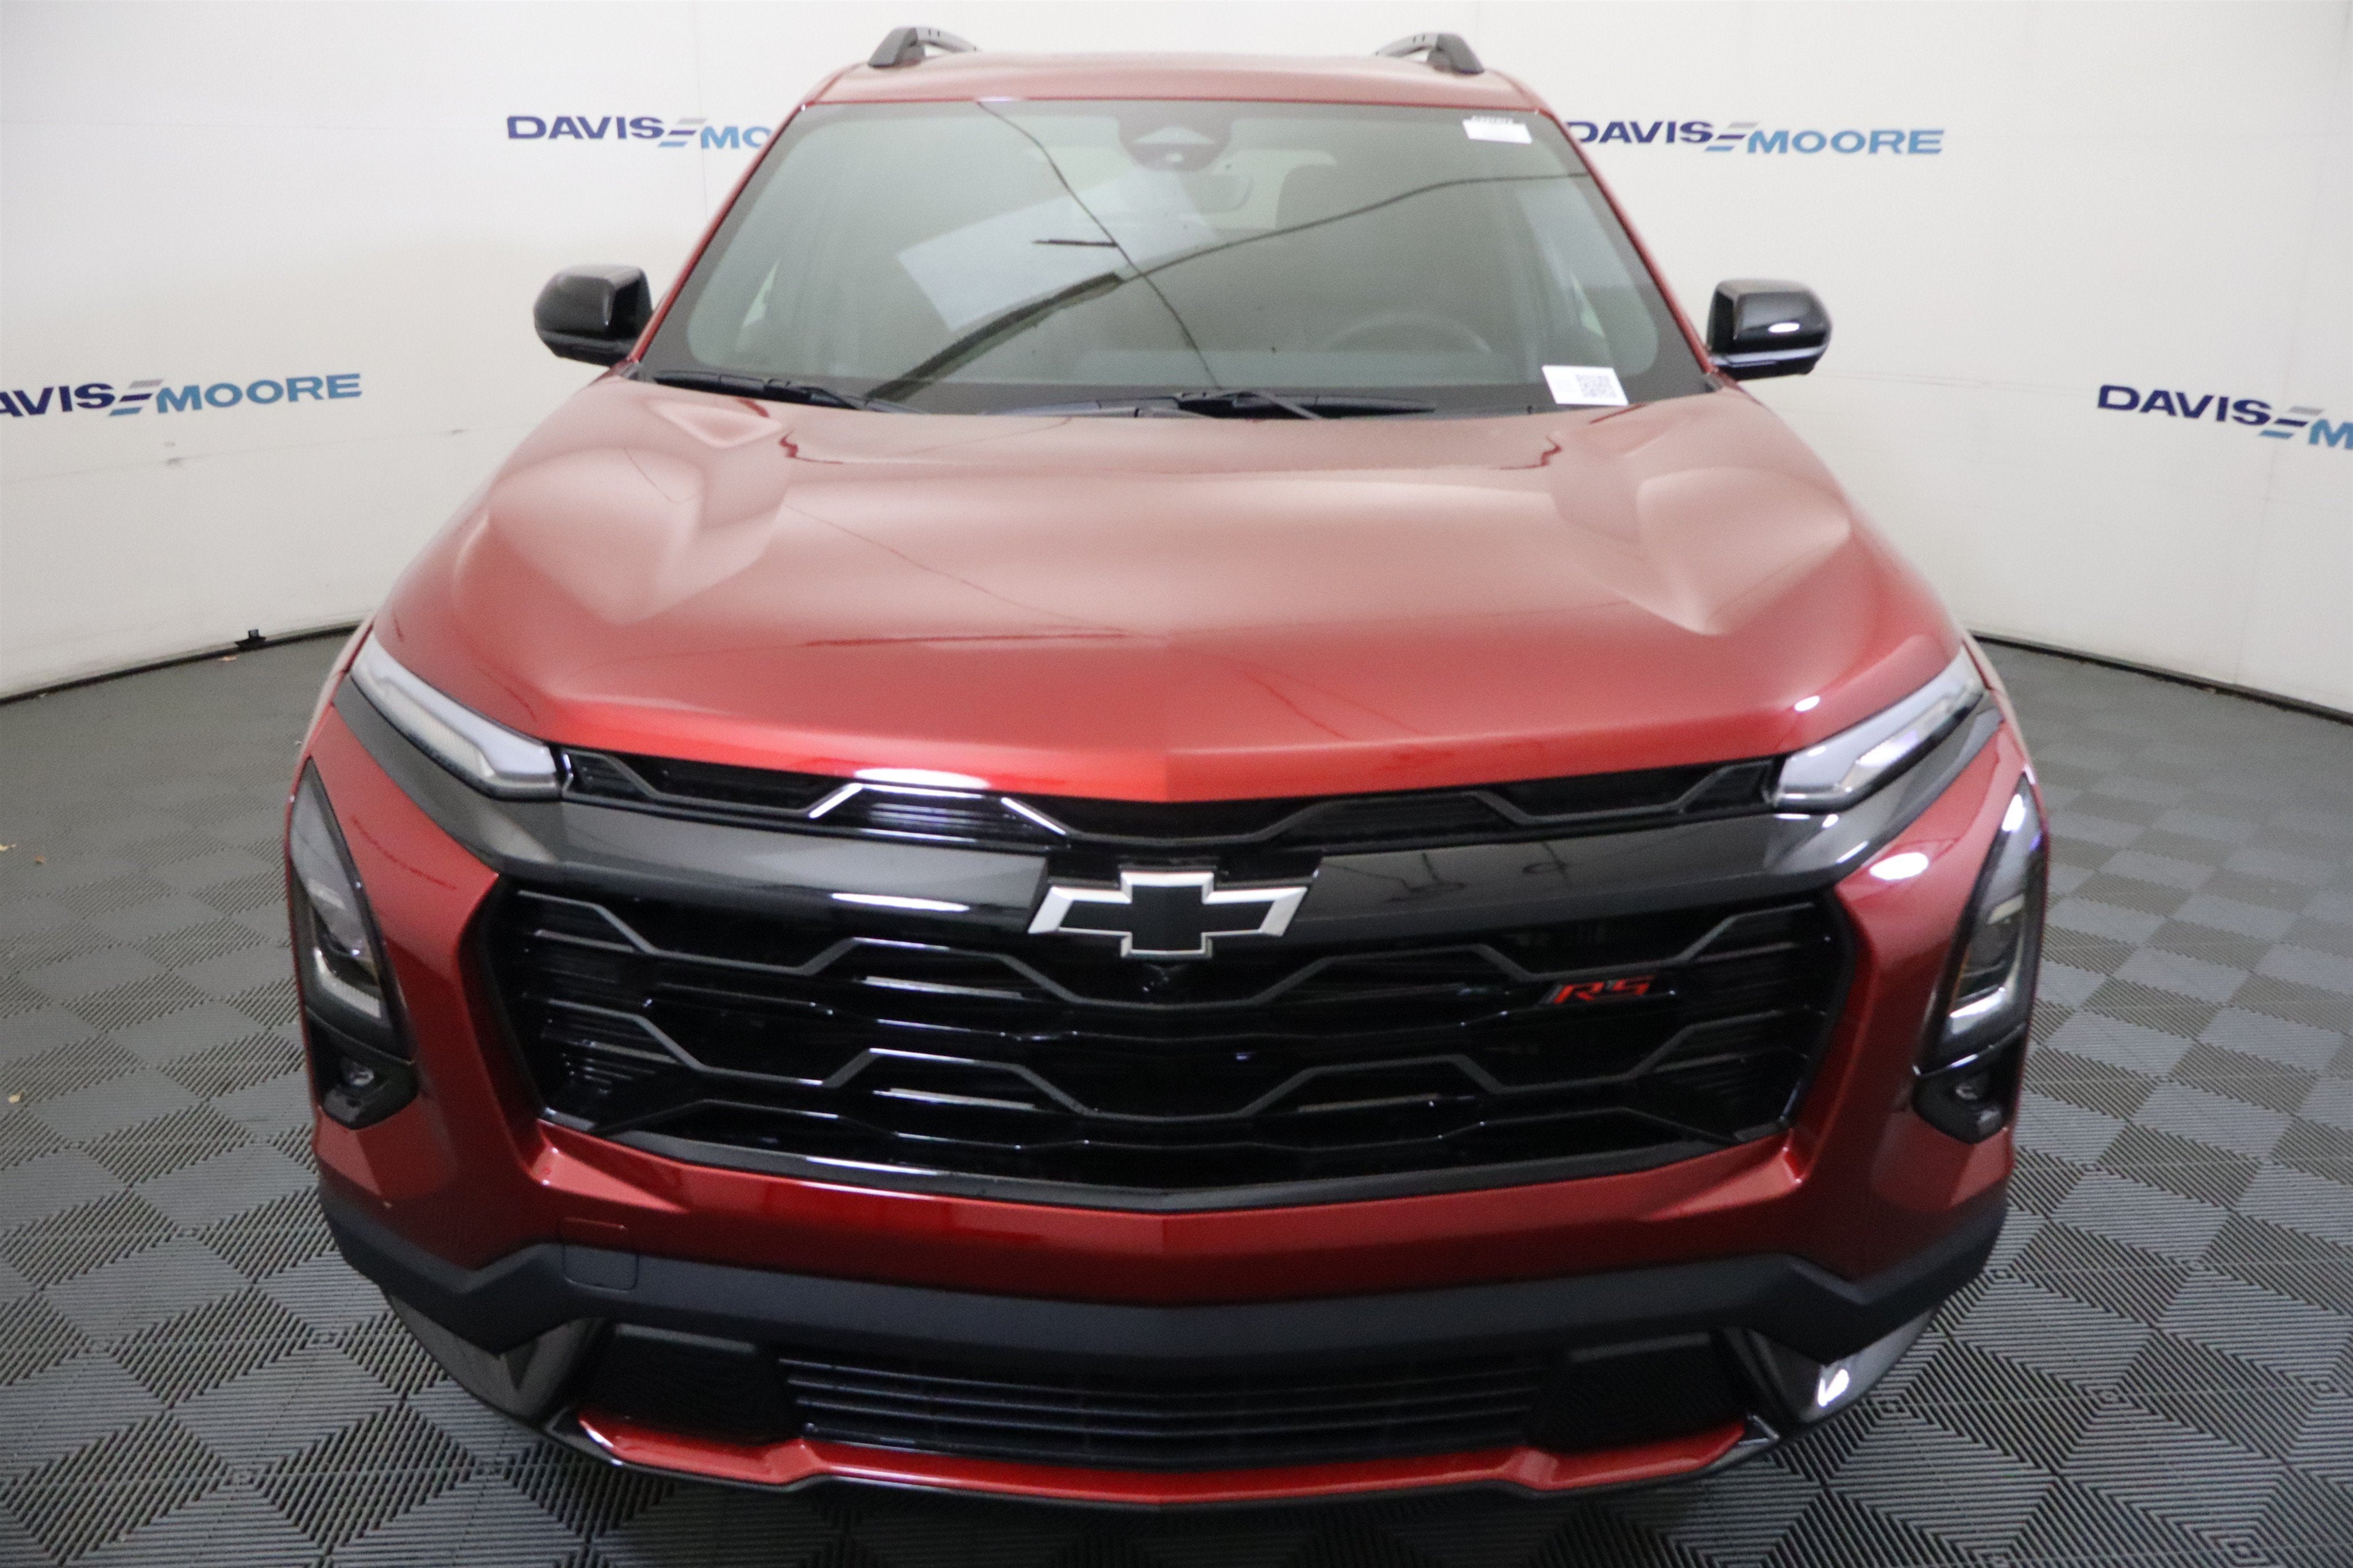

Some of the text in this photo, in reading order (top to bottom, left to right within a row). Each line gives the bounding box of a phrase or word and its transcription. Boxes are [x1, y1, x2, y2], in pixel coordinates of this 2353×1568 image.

[506, 115, 664, 140] DAVIS
[1567, 121, 1945, 155] DAVIS MOORE
[0, 373, 362, 417] AVIS MOORE
[2097, 384, 2272, 426] DAVIS
[1553, 975, 1655, 1004] RS
